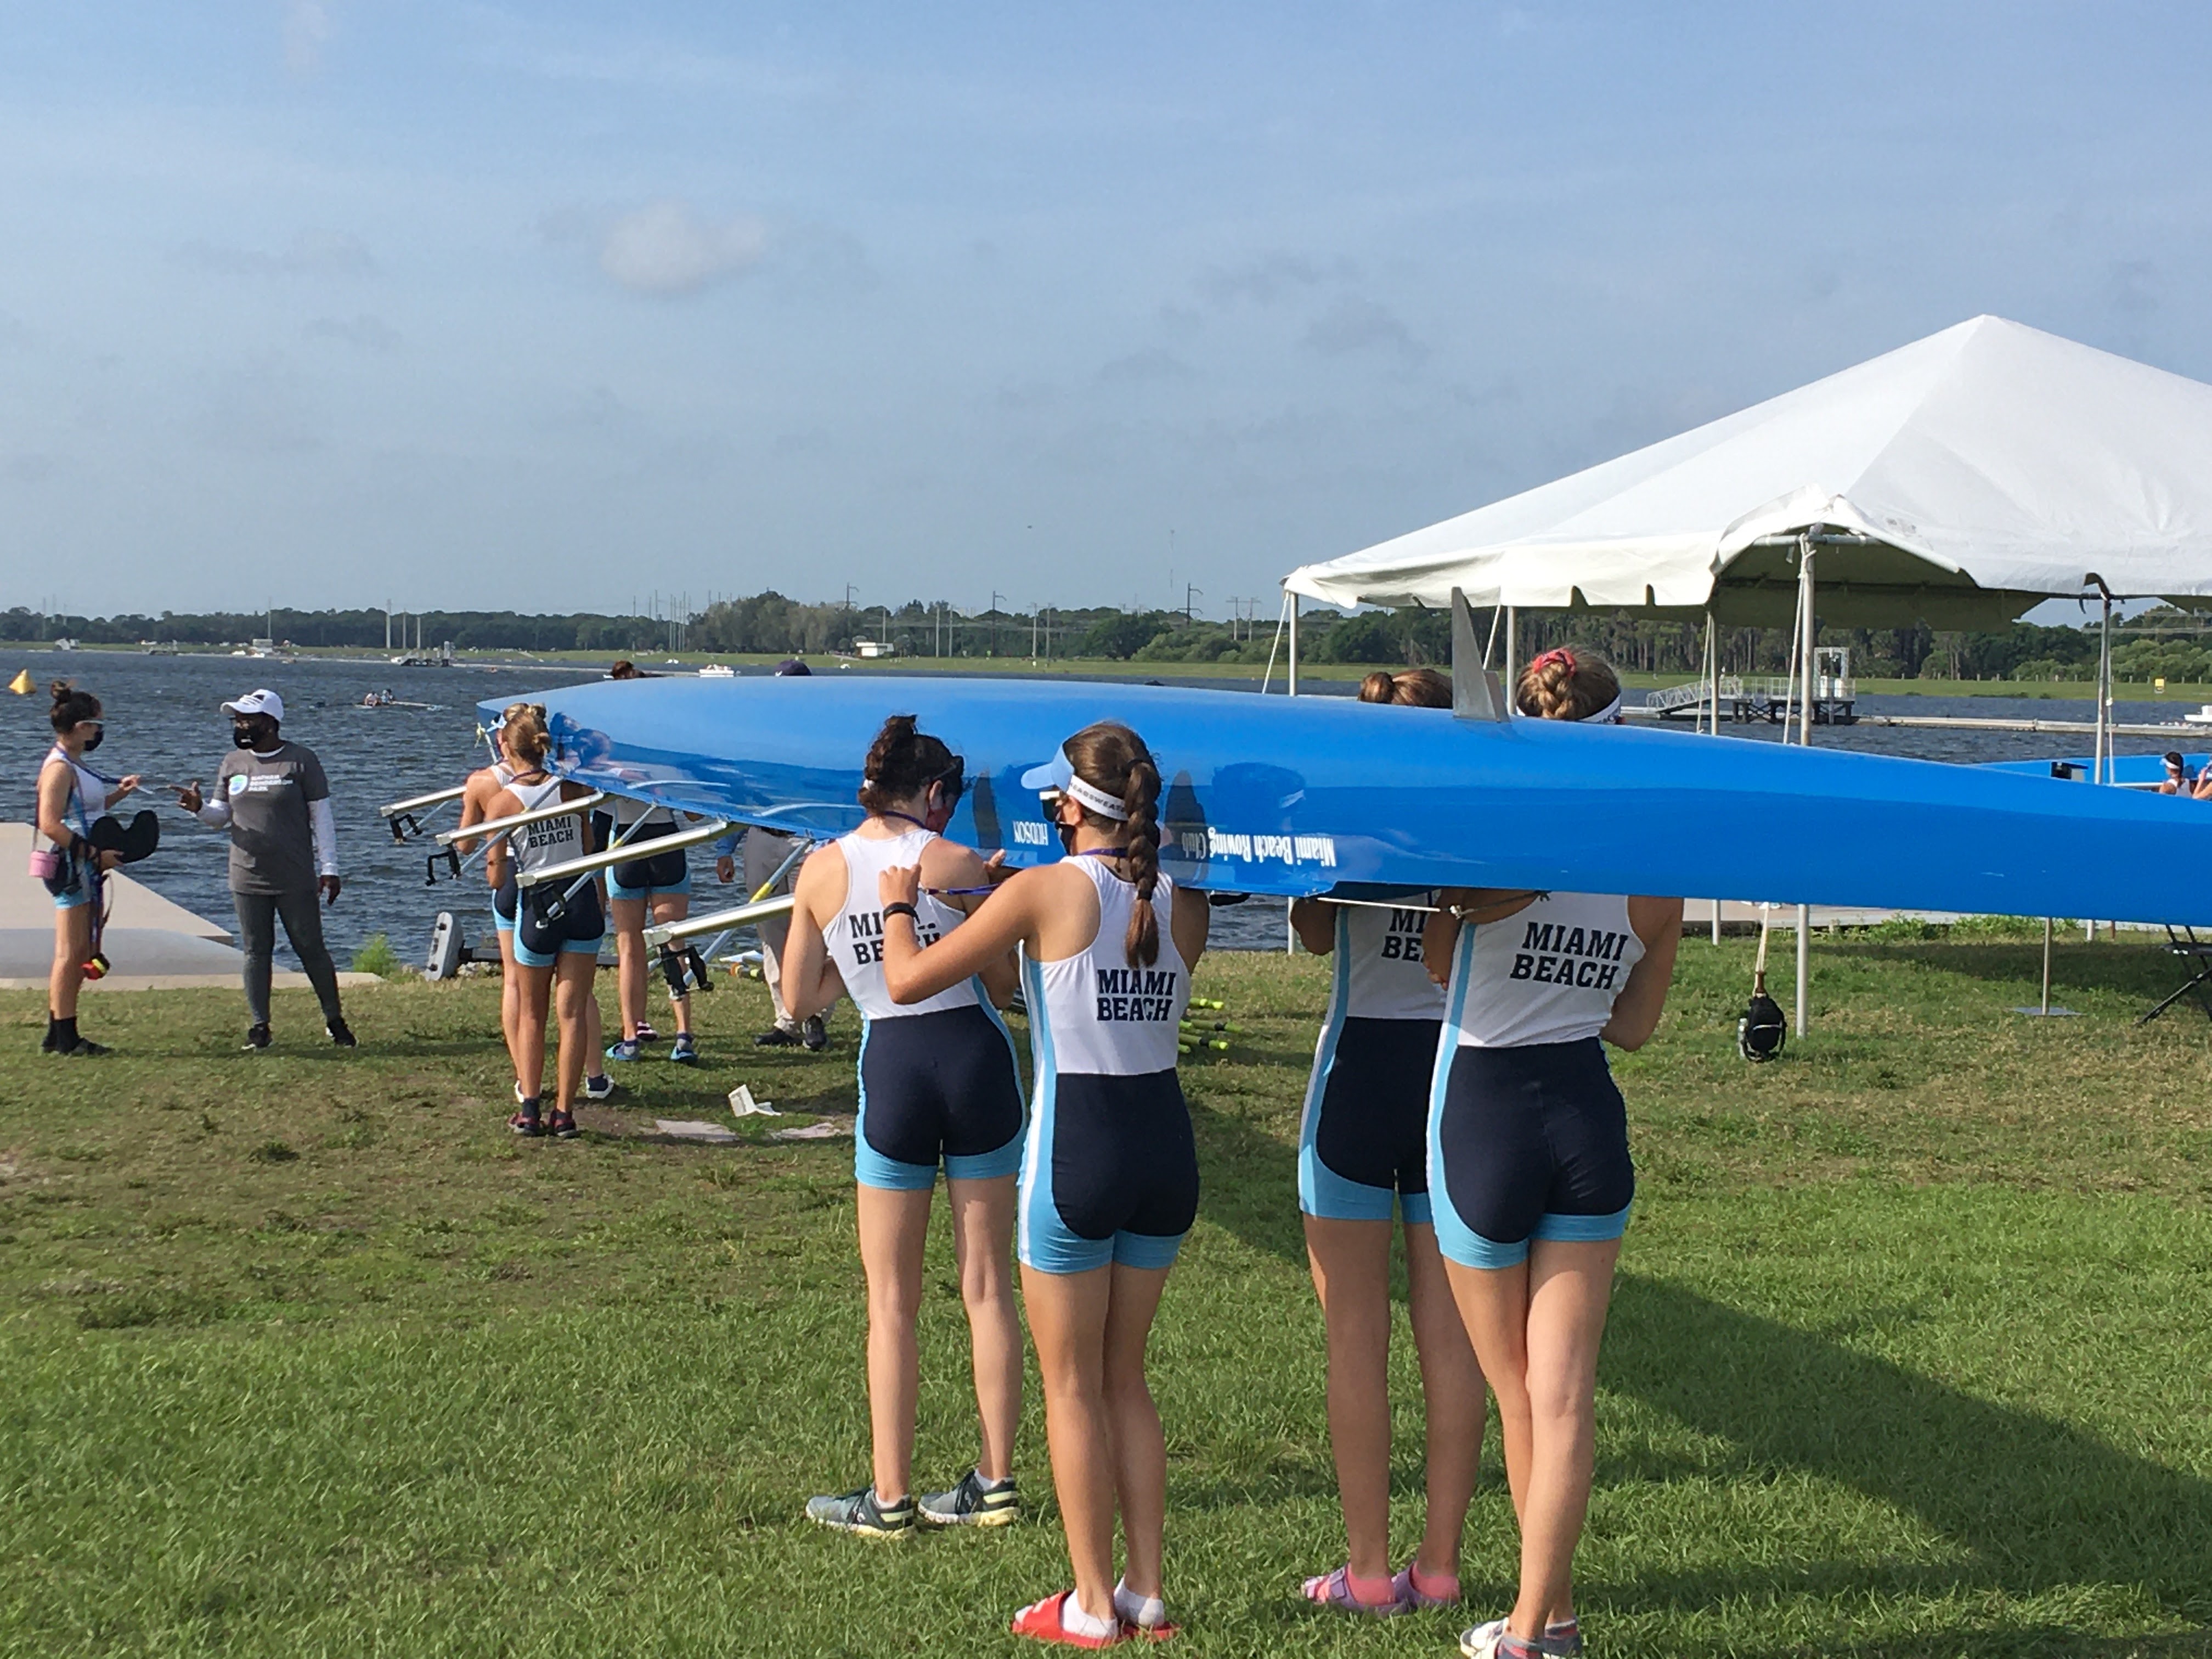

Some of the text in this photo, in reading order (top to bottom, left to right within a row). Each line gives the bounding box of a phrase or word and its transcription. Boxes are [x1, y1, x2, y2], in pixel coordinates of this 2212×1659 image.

[527, 816, 572, 836] MIAMI
[529, 829, 574, 848] BEACH
[1012, 821, 1048, 846] HUDSON
[1182, 827, 1336, 867] Miami Beach Rowing Club
[1522, 922, 1629, 961] MIAMI
[1097, 969, 1177, 996] MIAMI
[1510, 953, 1619, 990] BEACH
[1097, 997, 1173, 1021] BEACH
